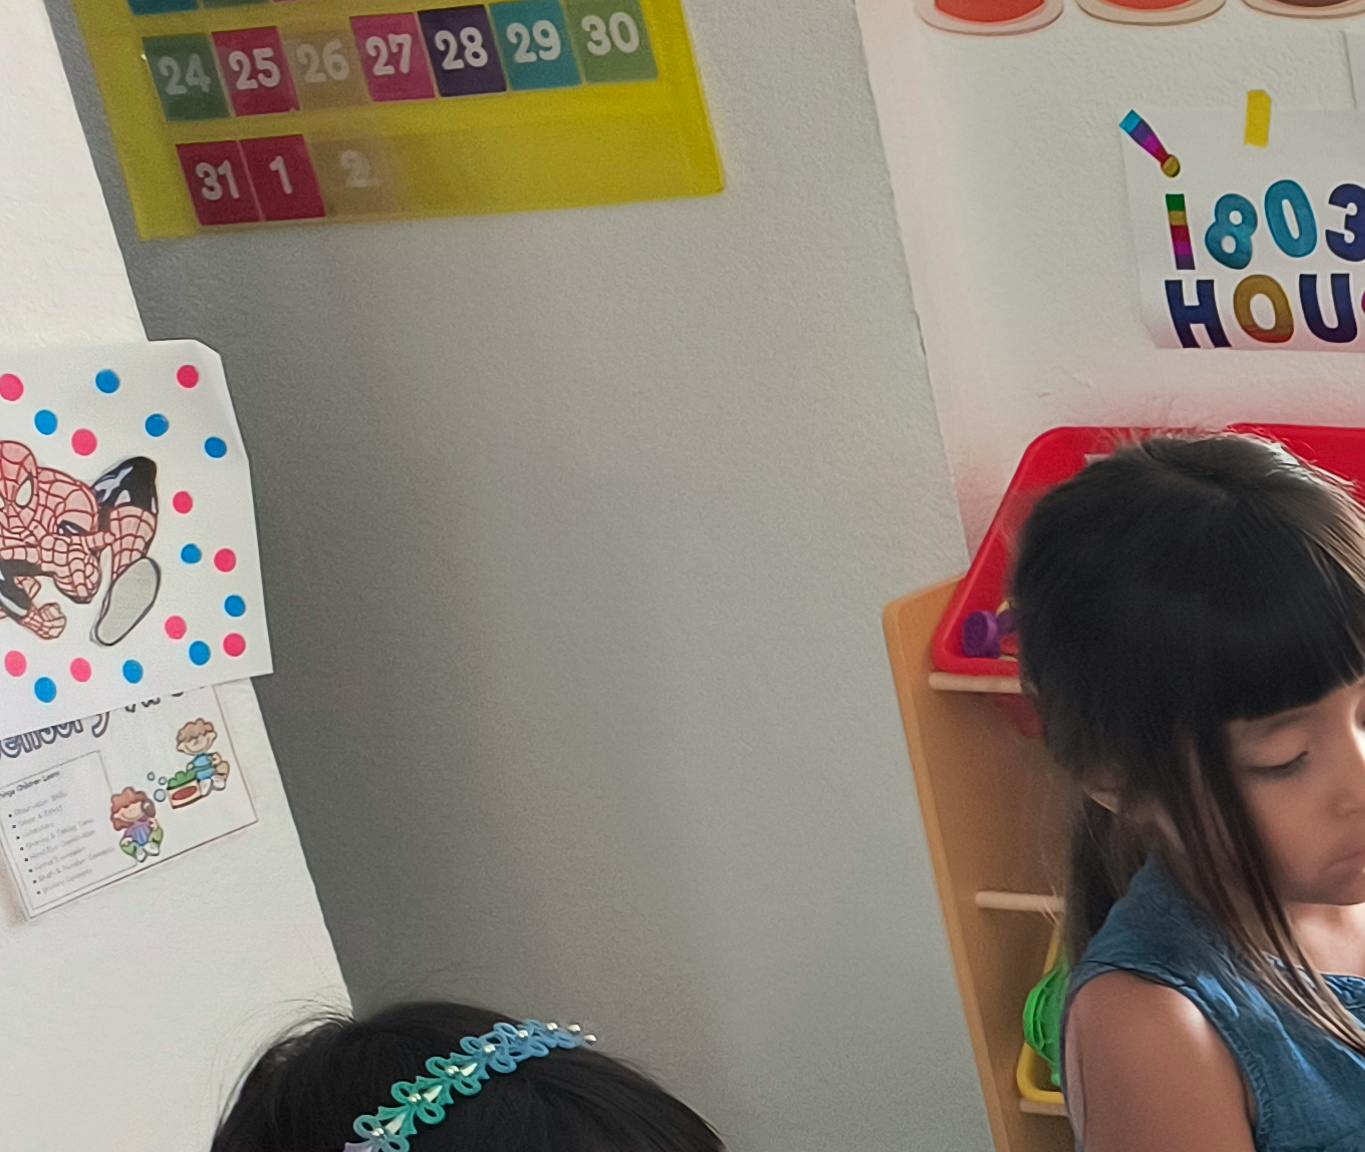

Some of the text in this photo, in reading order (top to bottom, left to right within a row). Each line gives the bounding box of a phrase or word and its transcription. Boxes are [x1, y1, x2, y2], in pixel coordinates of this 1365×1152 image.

[157, 11, 640, 95] 24 25 26 27 28 29 30
[195, 149, 373, 201] 31 1 2
